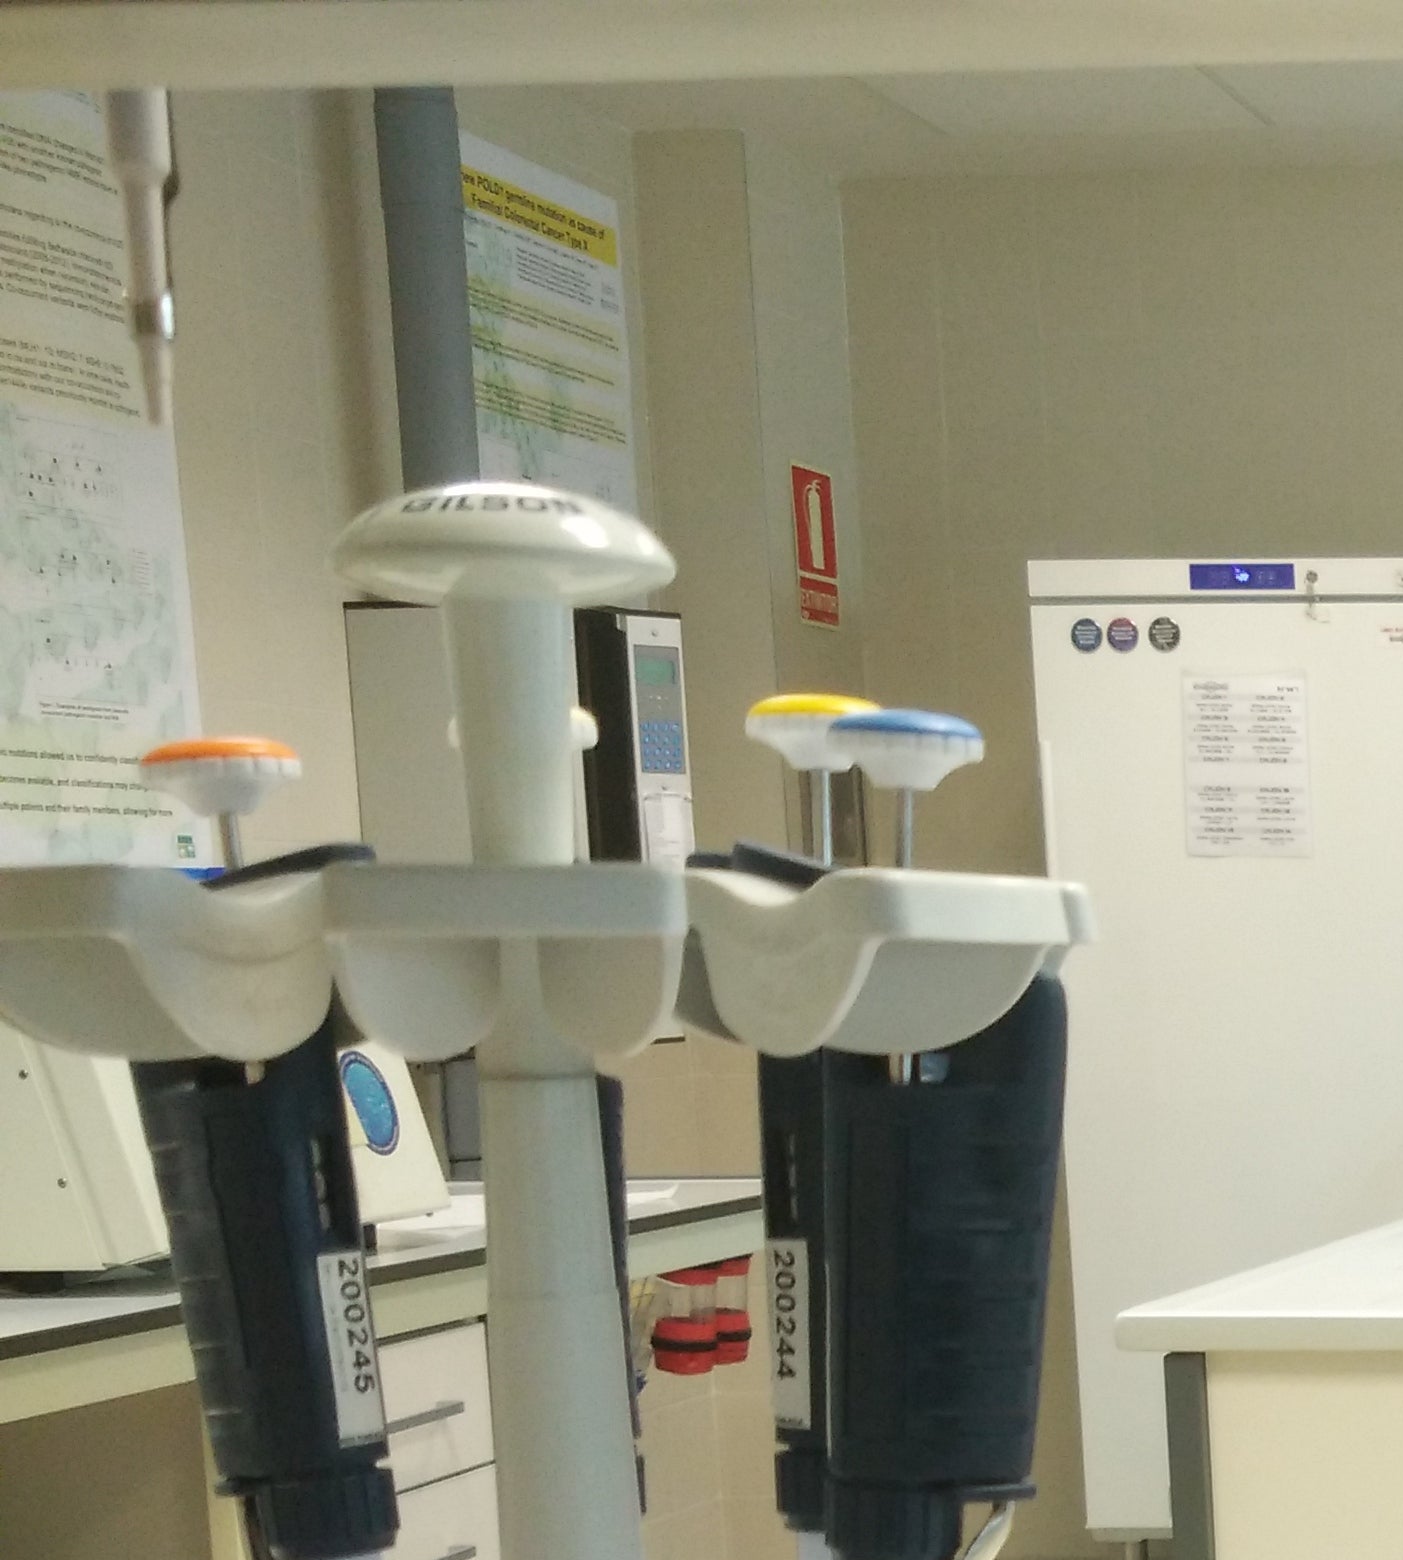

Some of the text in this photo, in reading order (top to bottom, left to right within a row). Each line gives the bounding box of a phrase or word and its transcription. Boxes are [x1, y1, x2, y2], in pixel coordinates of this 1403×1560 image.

[542, 222, 565, 240] Cancer
[337, 1258, 376, 1394] 200245
[773, 1249, 797, 1381] 200244
